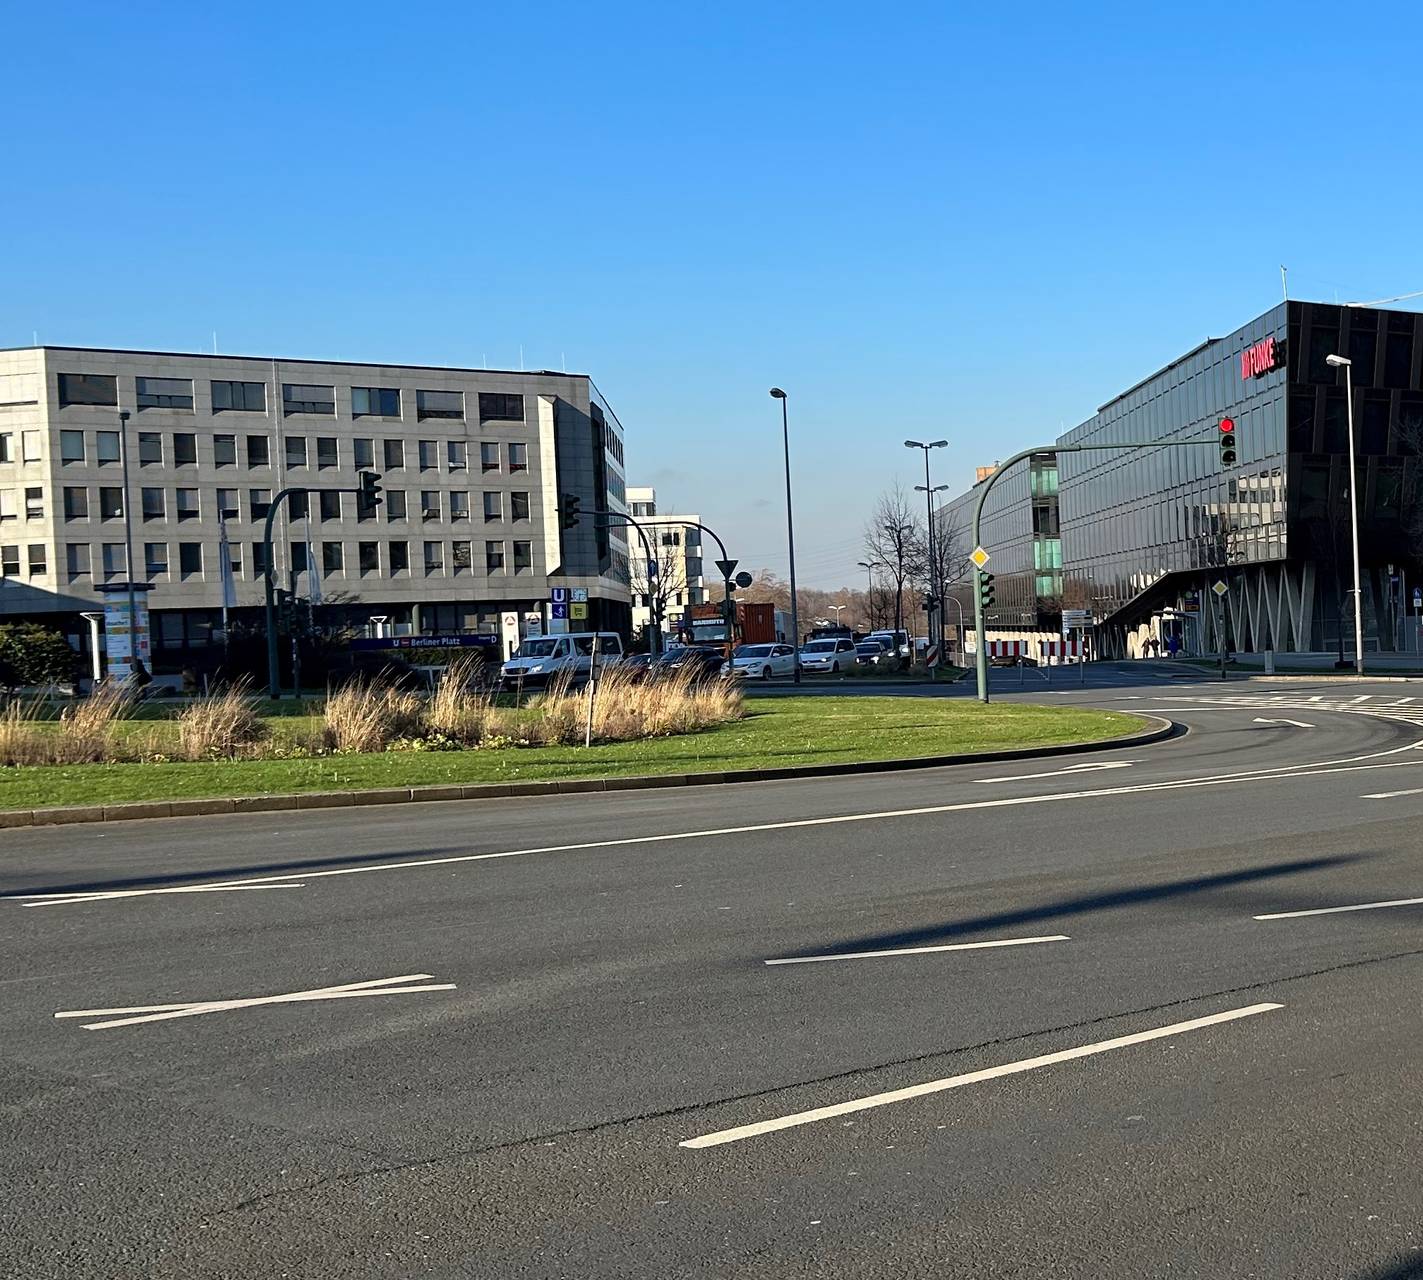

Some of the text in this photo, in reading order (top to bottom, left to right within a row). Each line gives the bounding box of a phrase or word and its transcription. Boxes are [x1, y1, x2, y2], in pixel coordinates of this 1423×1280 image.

[1250, 337, 1275, 377] FUNKE
[553, 589, 565, 602] U
[411, 639, 440, 647] Berliner
[442, 638, 461, 646] Platz
